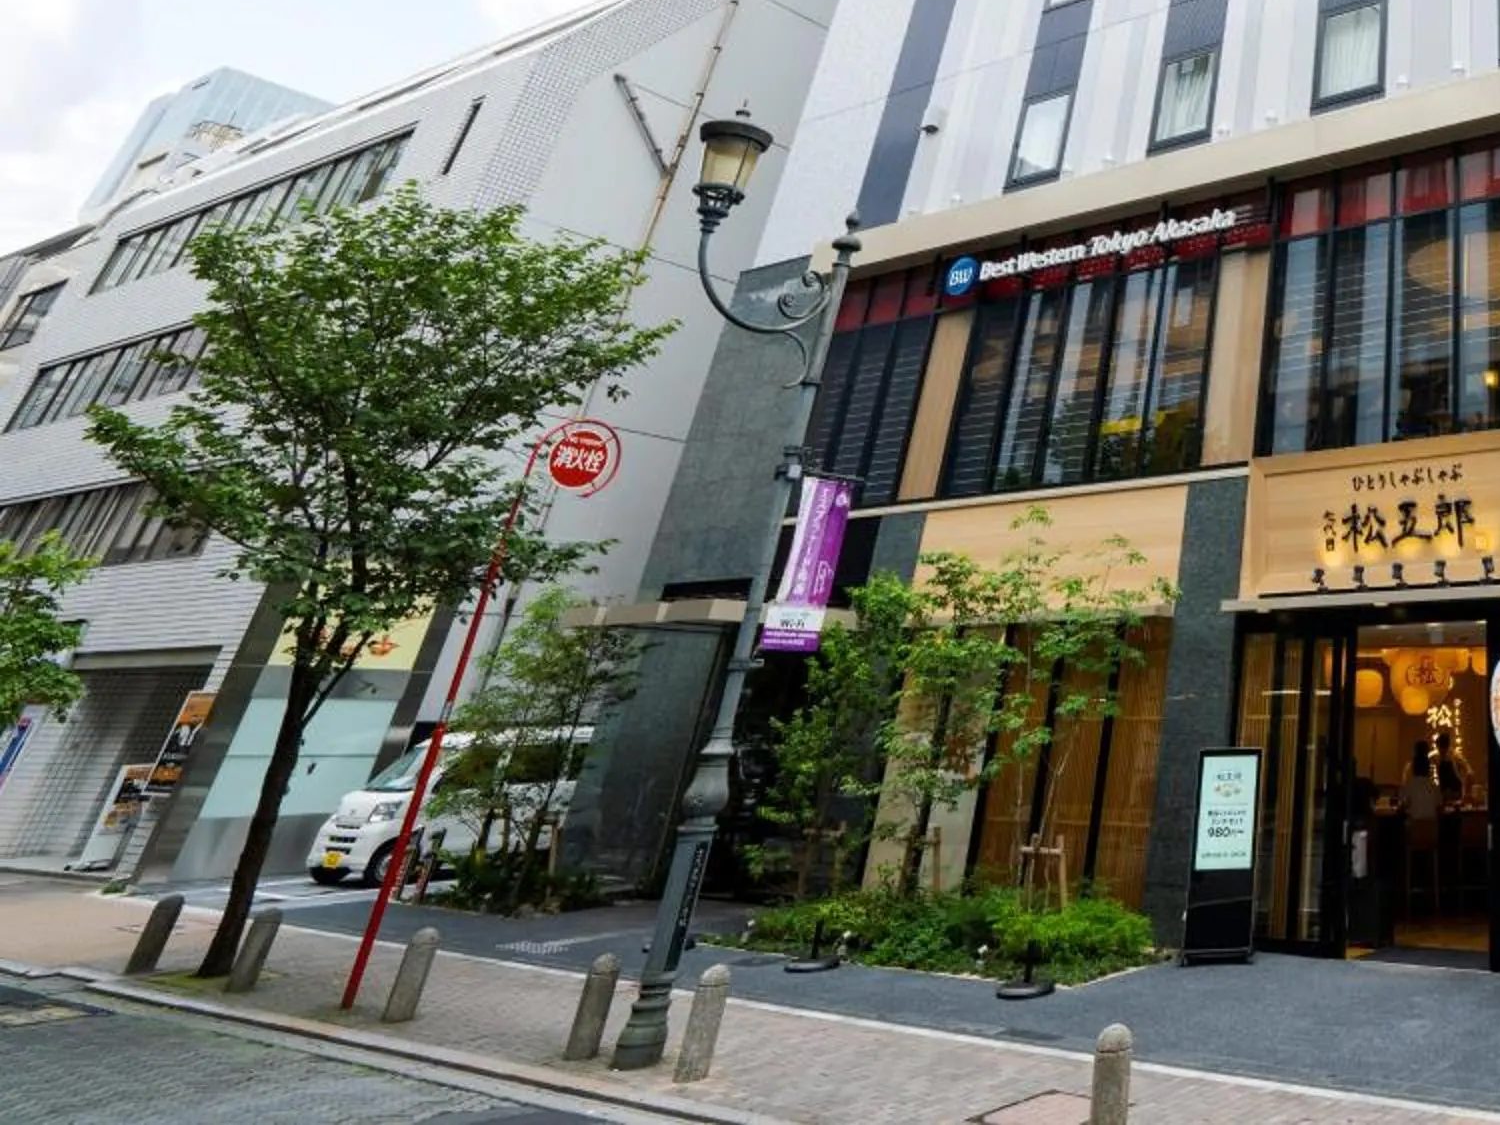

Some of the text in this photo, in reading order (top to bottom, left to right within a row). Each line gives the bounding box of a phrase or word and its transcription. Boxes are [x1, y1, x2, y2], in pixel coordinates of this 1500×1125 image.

[979, 208, 1237, 281] Best Western Tokyo Akasaka
[552, 444, 605, 473] 消火栓
[1352, 462, 1462, 491] ひとりしゃぶしゃぶ
[1341, 494, 1475, 553] 松五郎
